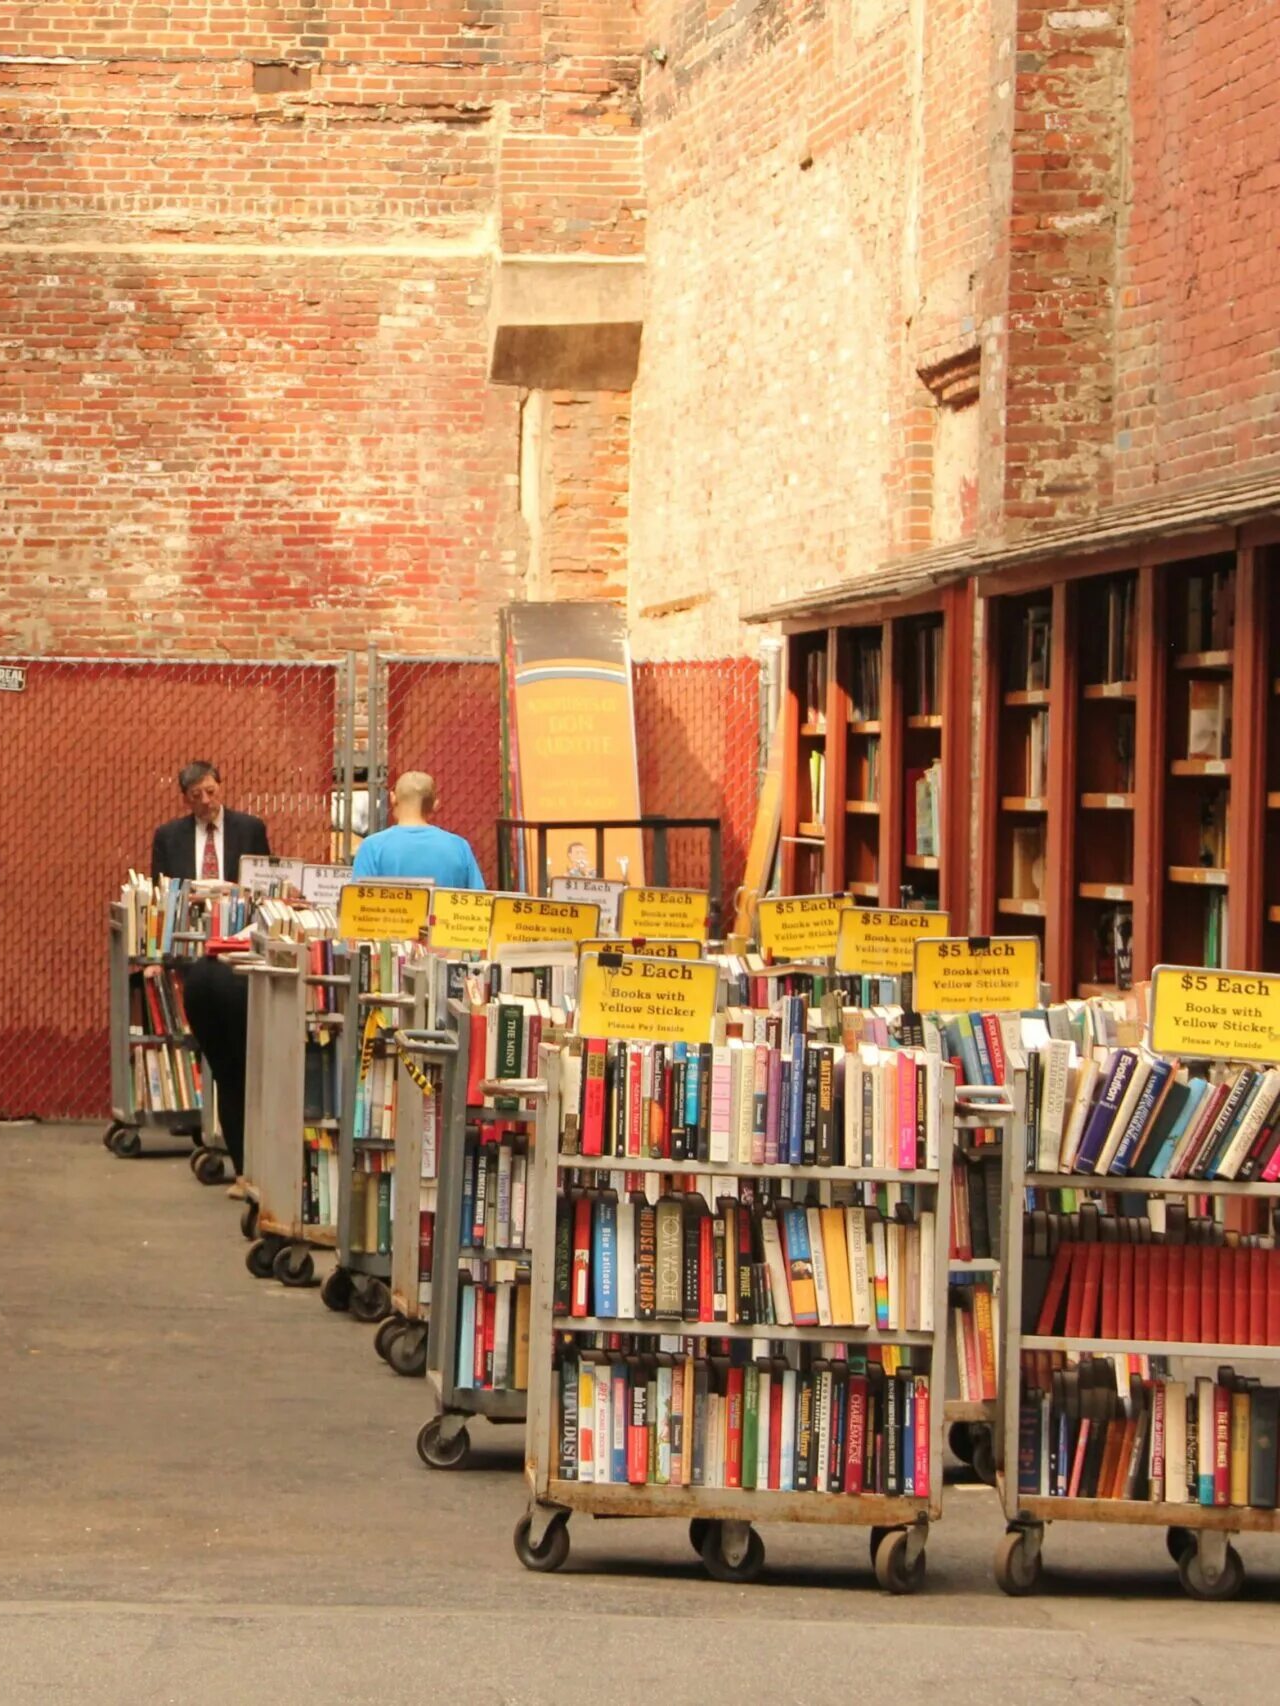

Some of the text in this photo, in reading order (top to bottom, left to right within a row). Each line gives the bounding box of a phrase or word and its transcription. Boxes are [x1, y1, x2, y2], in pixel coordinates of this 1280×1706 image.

[357, 886, 412, 900] $5 Each
[565, 882, 611, 892] $1 Each
[450, 893, 469, 905] $5
[638, 892, 692, 904] $5 Each
[513, 901, 579, 918] $5 Each
[641, 910, 666, 918] Books
[776, 899, 836, 914] $5 Each
[453, 913, 480, 921] Books
[861, 912, 929, 928] $5 Each
[445, 923, 474, 931] Yellow
[515, 923, 573, 934] Books with
[775, 932, 805, 941] Yellow
[864, 933, 896, 942] Books
[855, 944, 889, 954] Yellow
[938, 942, 961, 958] $5
[642, 962, 692, 980] Each
[943, 966, 1010, 976] Books with
[933, 979, 1019, 989] Yellow Sticker
[1181, 972, 1270, 996] $5 Each
[612, 988, 685, 1001] Books with
[600, 1002, 695, 1016] Yellow Sticker
[1185, 1002, 1262, 1018] Books with
[608, 1021, 684, 1032] Please Pay Inside
[986, 1018, 997, 1035] JODI
[1173, 1016, 1274, 1033] Yellow Sticker
[506, 1020, 517, 1067] THE MIND
[1182, 1036, 1262, 1049] Please Pay Inside
[654, 1050, 662, 1074] Richard
[688, 1063, 699, 1098] EVIL
[820, 1060, 831, 1111] BATTLESHIP
[1106, 1054, 1132, 1101] Evolution
[476, 1156, 487, 1224] THE LONGEST WINTER
[601, 1227, 611, 1295] Blue Latitudes
[640, 1214, 654, 1309] HOUSE OF LORDS
[661, 1213, 679, 1302] TOM WOLFE
[740, 1266, 751, 1298] PRIVATE
[598, 1382, 608, 1403] PREY
[801, 1388, 812, 1425] Mammal
[1217, 1411, 1228, 1424] THE
[849, 1394, 861, 1464] CHARLEMAGNE
[1217, 1425, 1228, 1440] KITE
[563, 1426, 577, 1462] DUST
